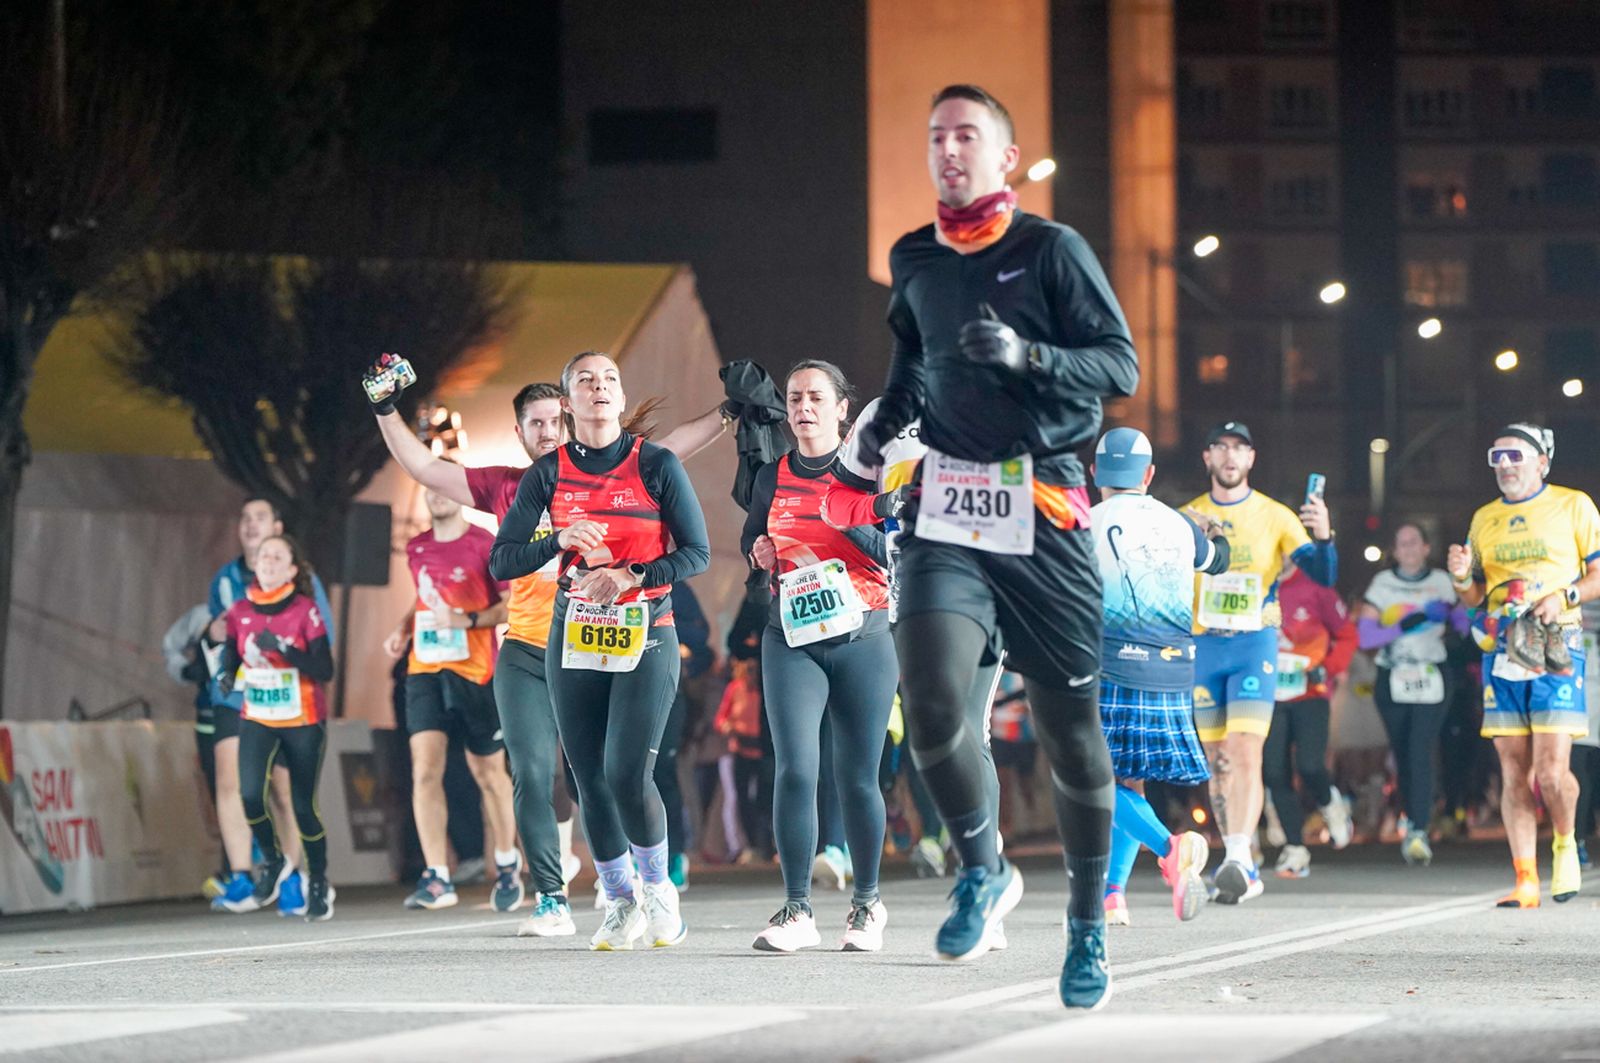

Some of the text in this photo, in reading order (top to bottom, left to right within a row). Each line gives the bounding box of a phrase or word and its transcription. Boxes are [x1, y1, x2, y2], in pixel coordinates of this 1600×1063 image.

[944, 487, 1011, 518] 2430
[574, 614, 590, 624] SAN
[591, 616, 619, 626] ANTÓN
[584, 607, 608, 616] NOCHE
[609, 609, 619, 617] DE
[581, 624, 631, 649] 6133
[31, 767, 75, 813] SAN
